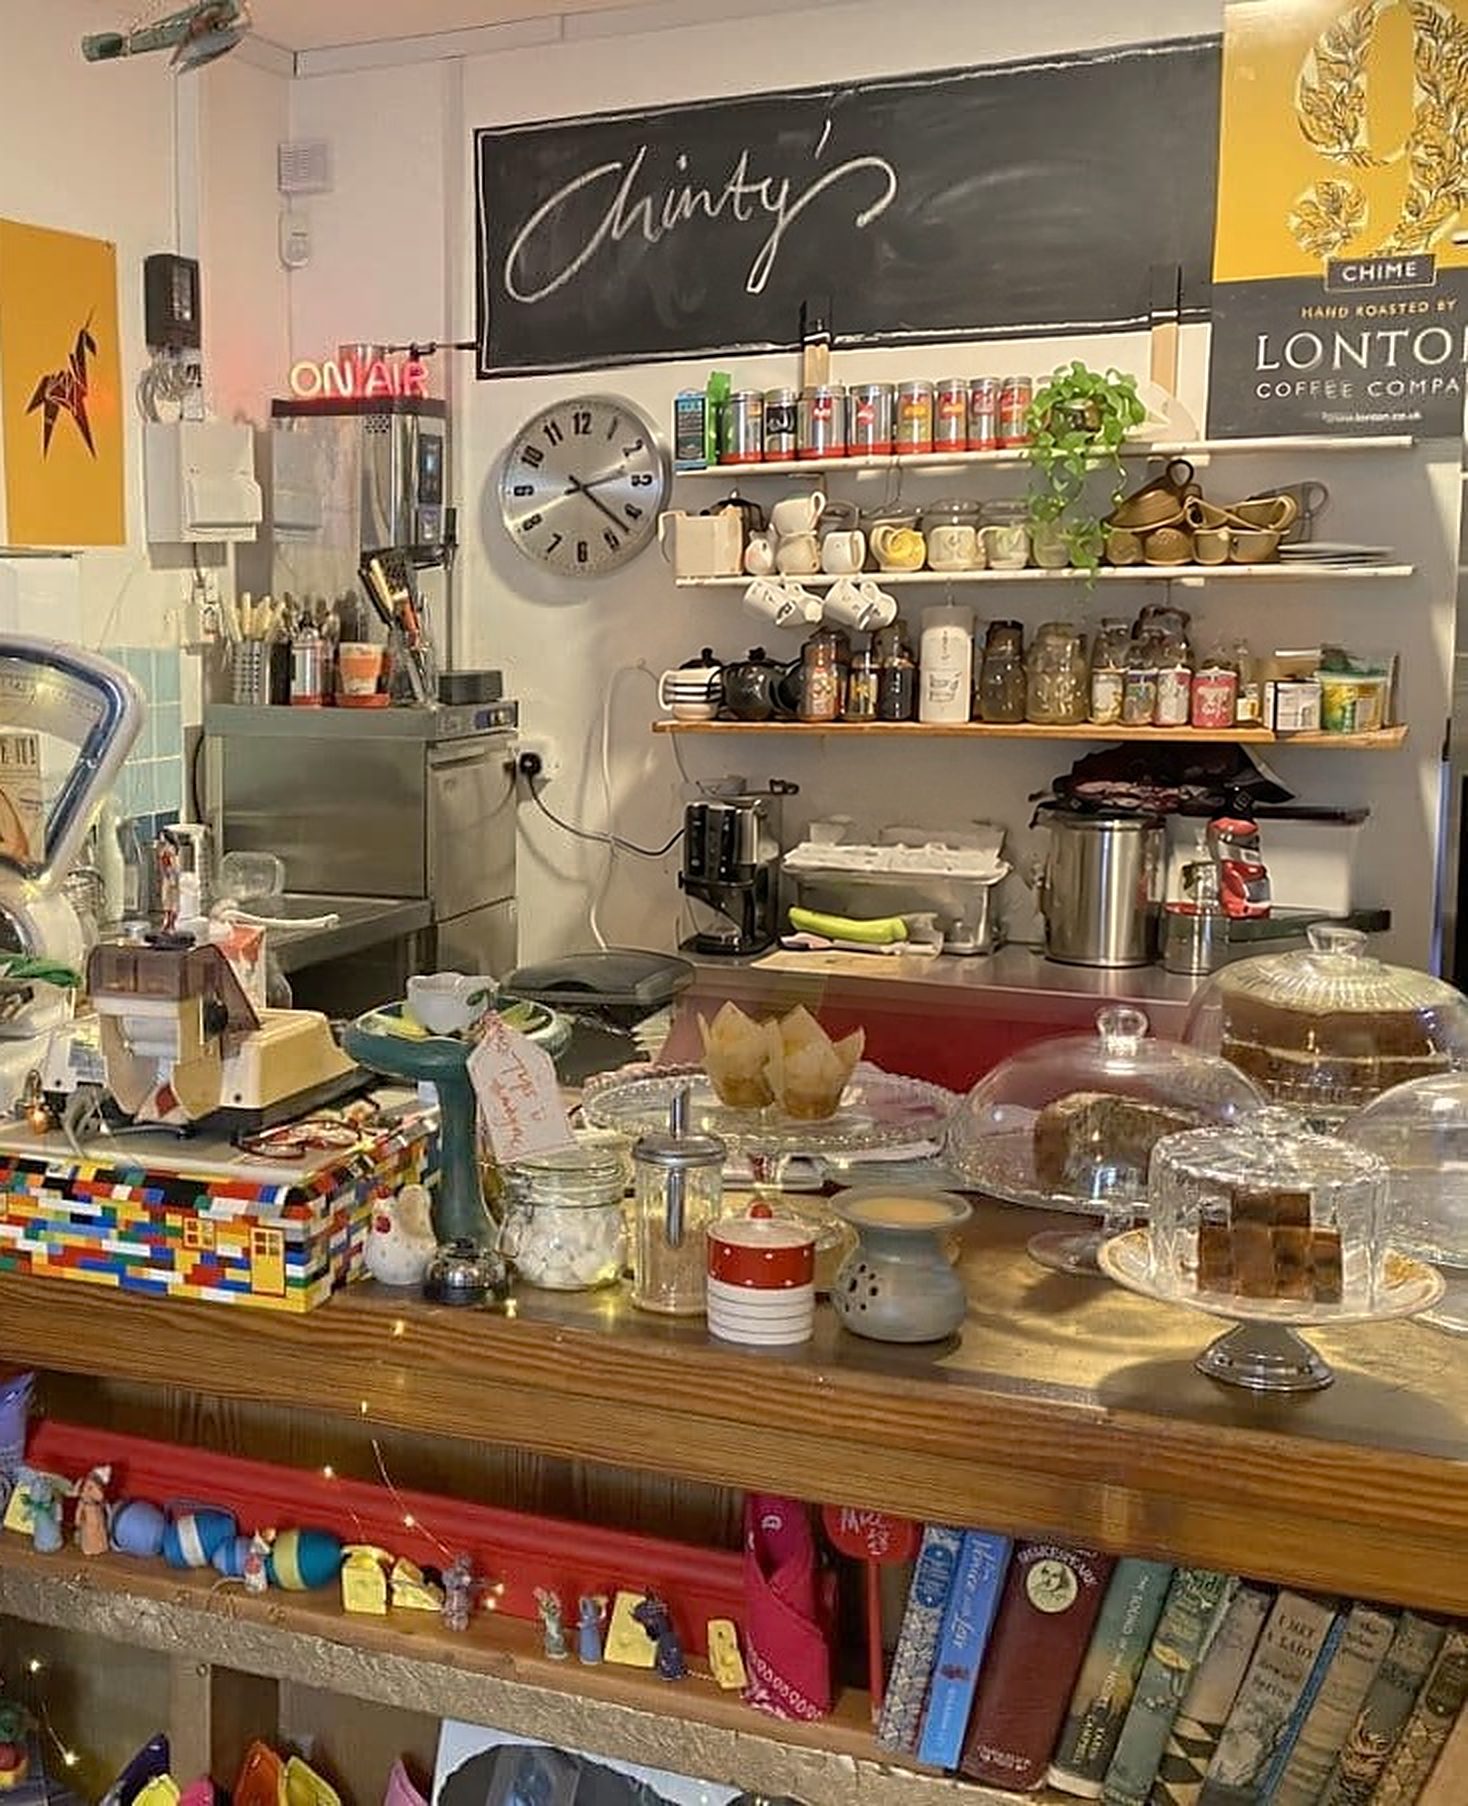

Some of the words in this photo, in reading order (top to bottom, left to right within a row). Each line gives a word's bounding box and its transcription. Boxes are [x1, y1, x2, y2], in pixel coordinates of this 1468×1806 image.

[1342, 261, 1418, 283] CHIME
[1301, 305, 1349, 319] HAND
[1356, 301, 1429, 317] ROASTED
[1437, 299, 1457, 312] BY
[1255, 328, 1468, 371] LONTO
[290, 360, 354, 397] ON
[364, 360, 429, 398] AIR
[1256, 379, 1353, 399] COFFEE
[1367, 378, 1461, 397] COMPA
[543, 421, 563, 446] 11
[573, 412, 592, 435] 12
[607, 416, 619, 440] 1
[521, 445, 544, 469] 10
[623, 439, 643, 458] 2
[513, 485, 534, 497] 9
[631, 474, 652, 487] 3
[522, 513, 543, 531] 8
[624, 503, 643, 520] 4
[547, 533, 562, 553] 7
[603, 530, 620, 549] 5
[577, 541, 588, 563] 6
